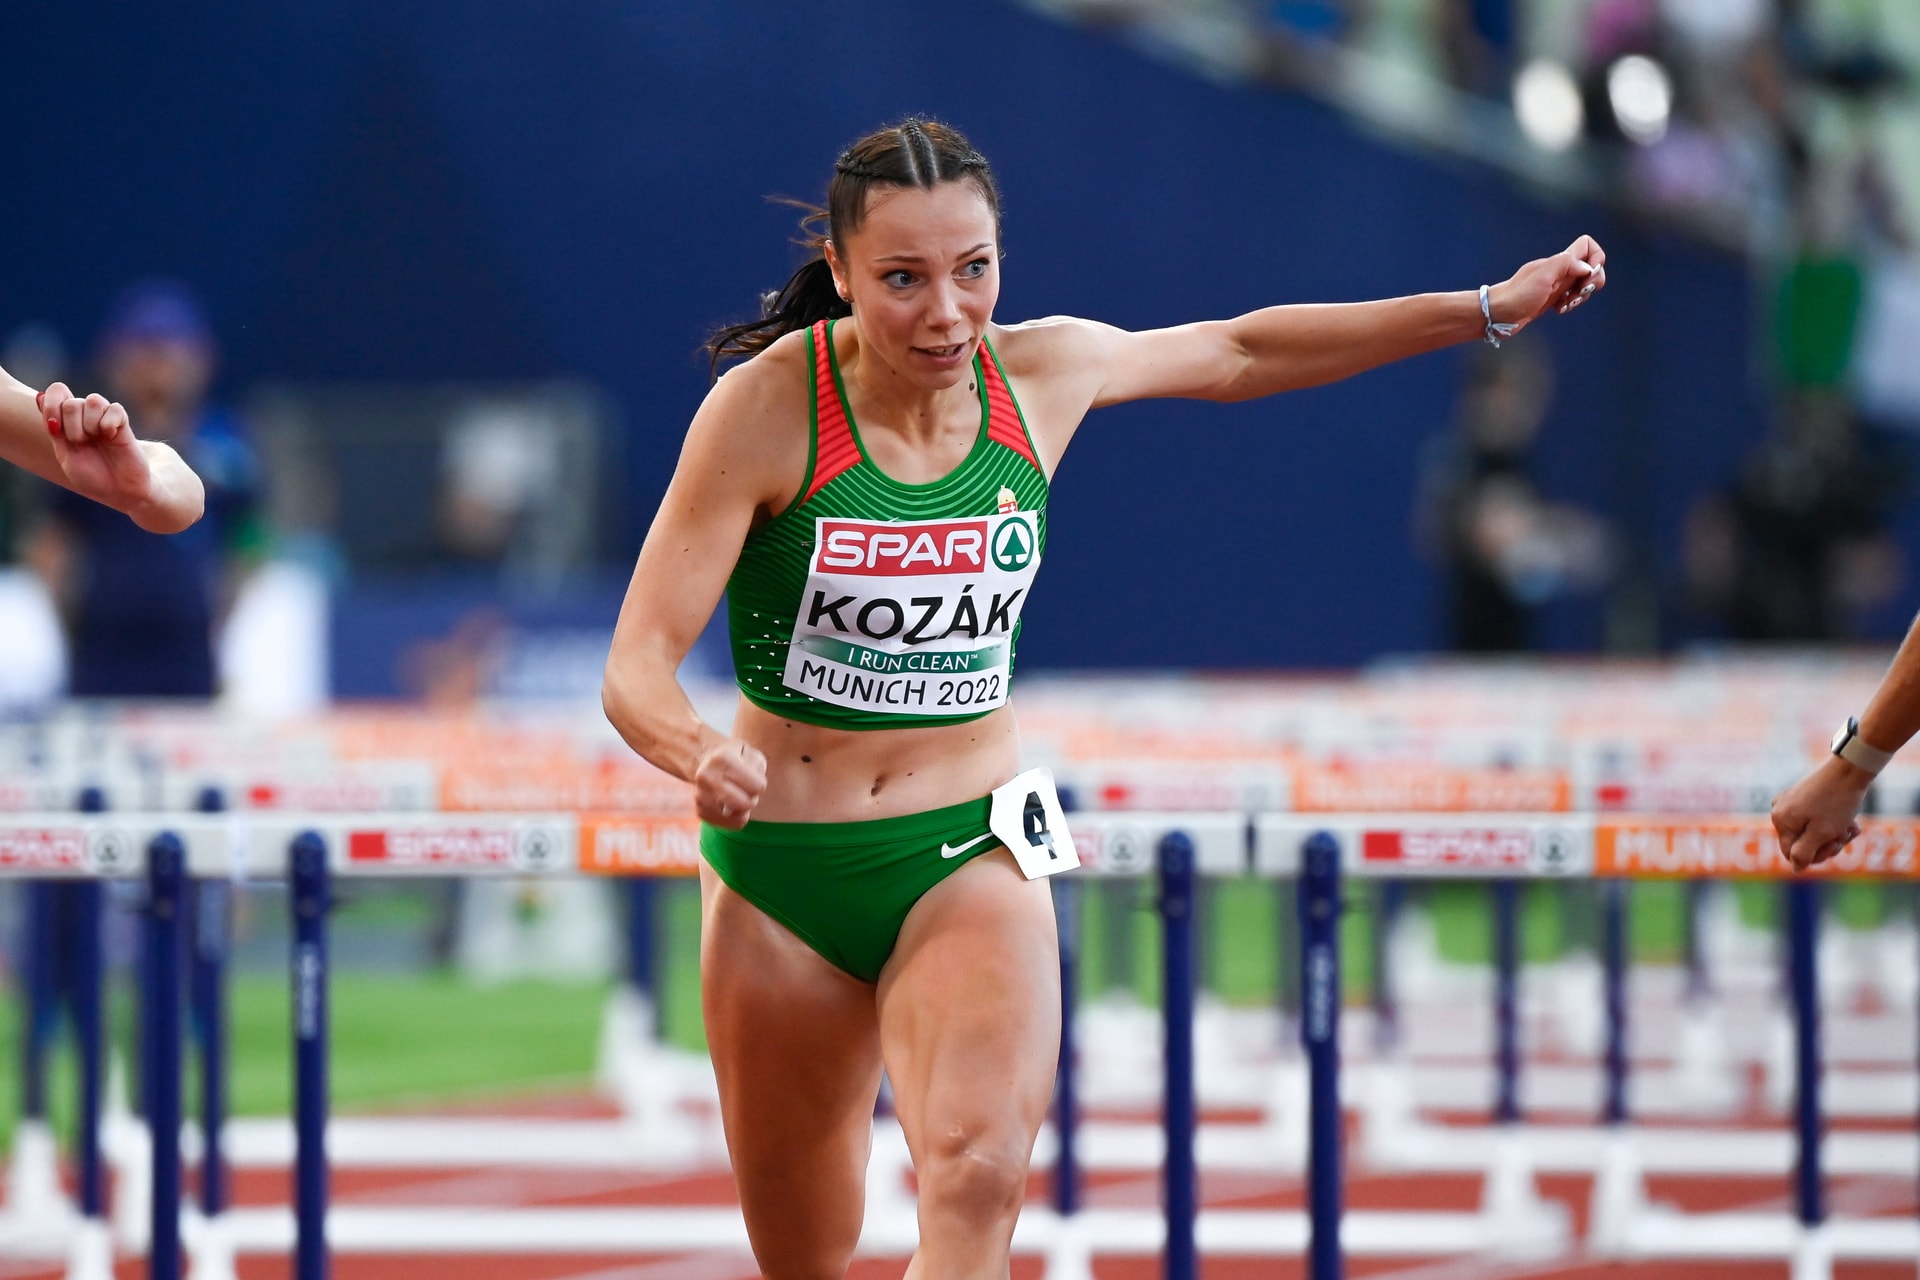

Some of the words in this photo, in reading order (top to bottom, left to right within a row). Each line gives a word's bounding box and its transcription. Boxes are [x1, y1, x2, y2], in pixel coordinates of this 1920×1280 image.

[823, 529, 983, 569] SPAR
[806, 584, 1024, 645] KOZÁK
[799, 659, 927, 706] MUNICH
[936, 674, 1001, 706] 2022
[847, 647, 855, 663] I
[859, 650, 903, 671] RUN
[1022, 790, 1058, 860] 4
